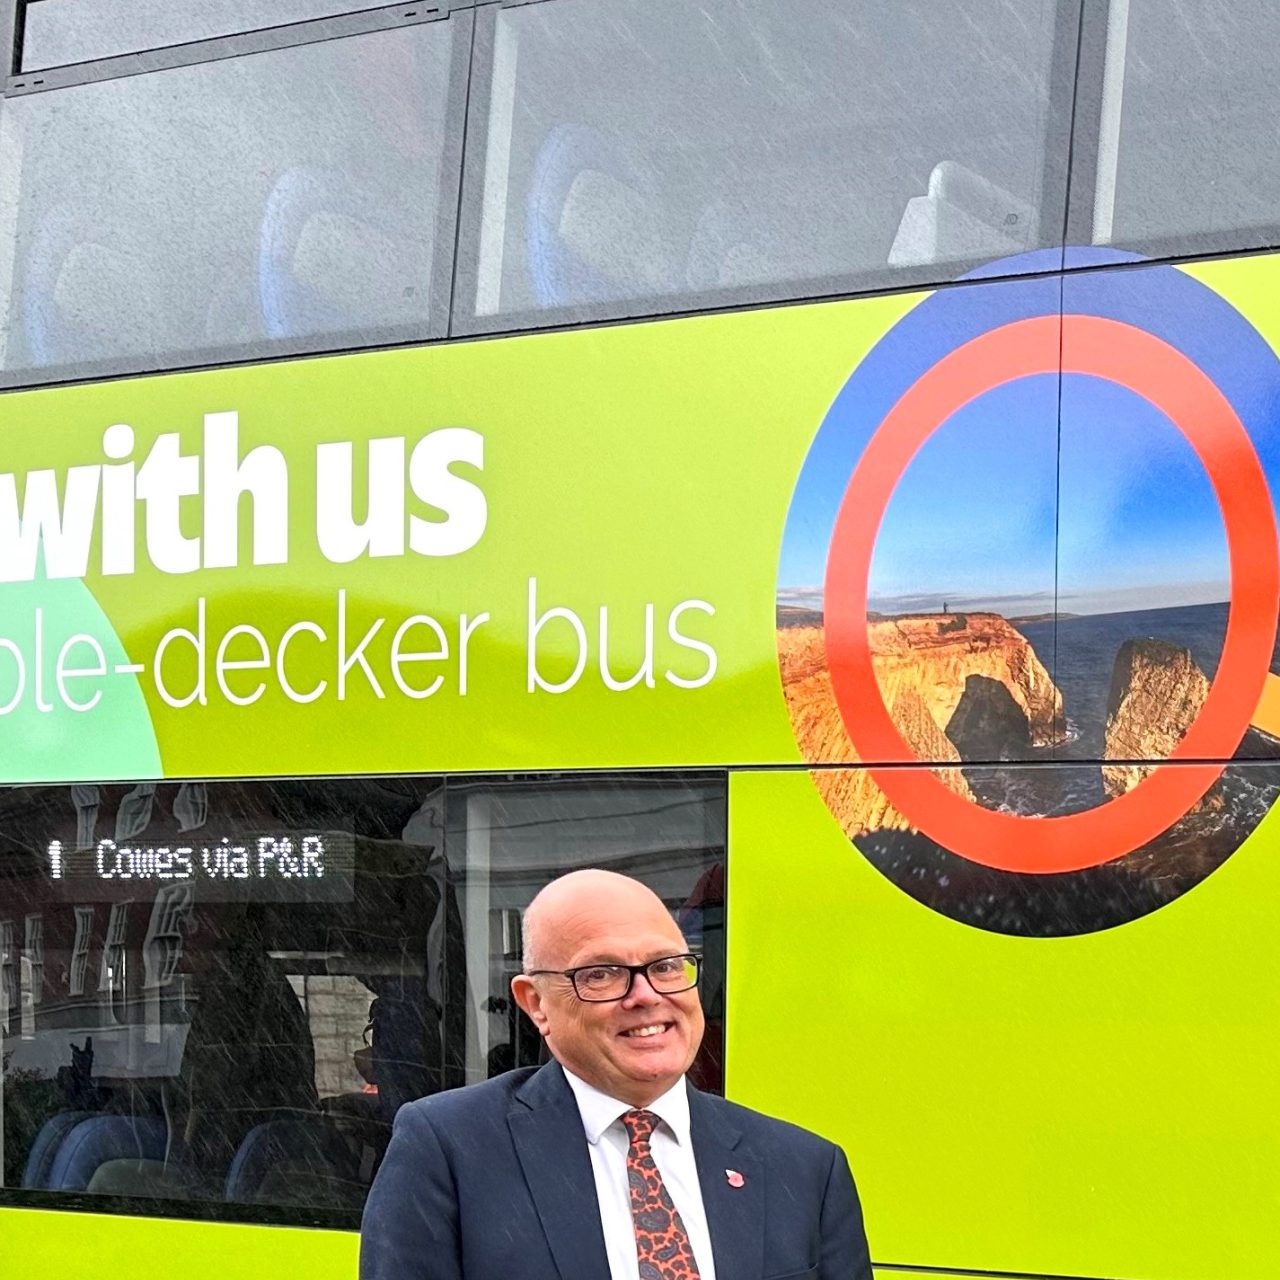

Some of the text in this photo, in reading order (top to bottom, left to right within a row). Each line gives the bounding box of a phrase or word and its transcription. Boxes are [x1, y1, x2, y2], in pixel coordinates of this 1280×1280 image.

[0, 411, 488, 583] with us
[528, 576, 718, 694] bus
[96, 839, 194, 879] Cowes
[201, 837, 250, 879] via
[257, 836, 325, 879] P&R
